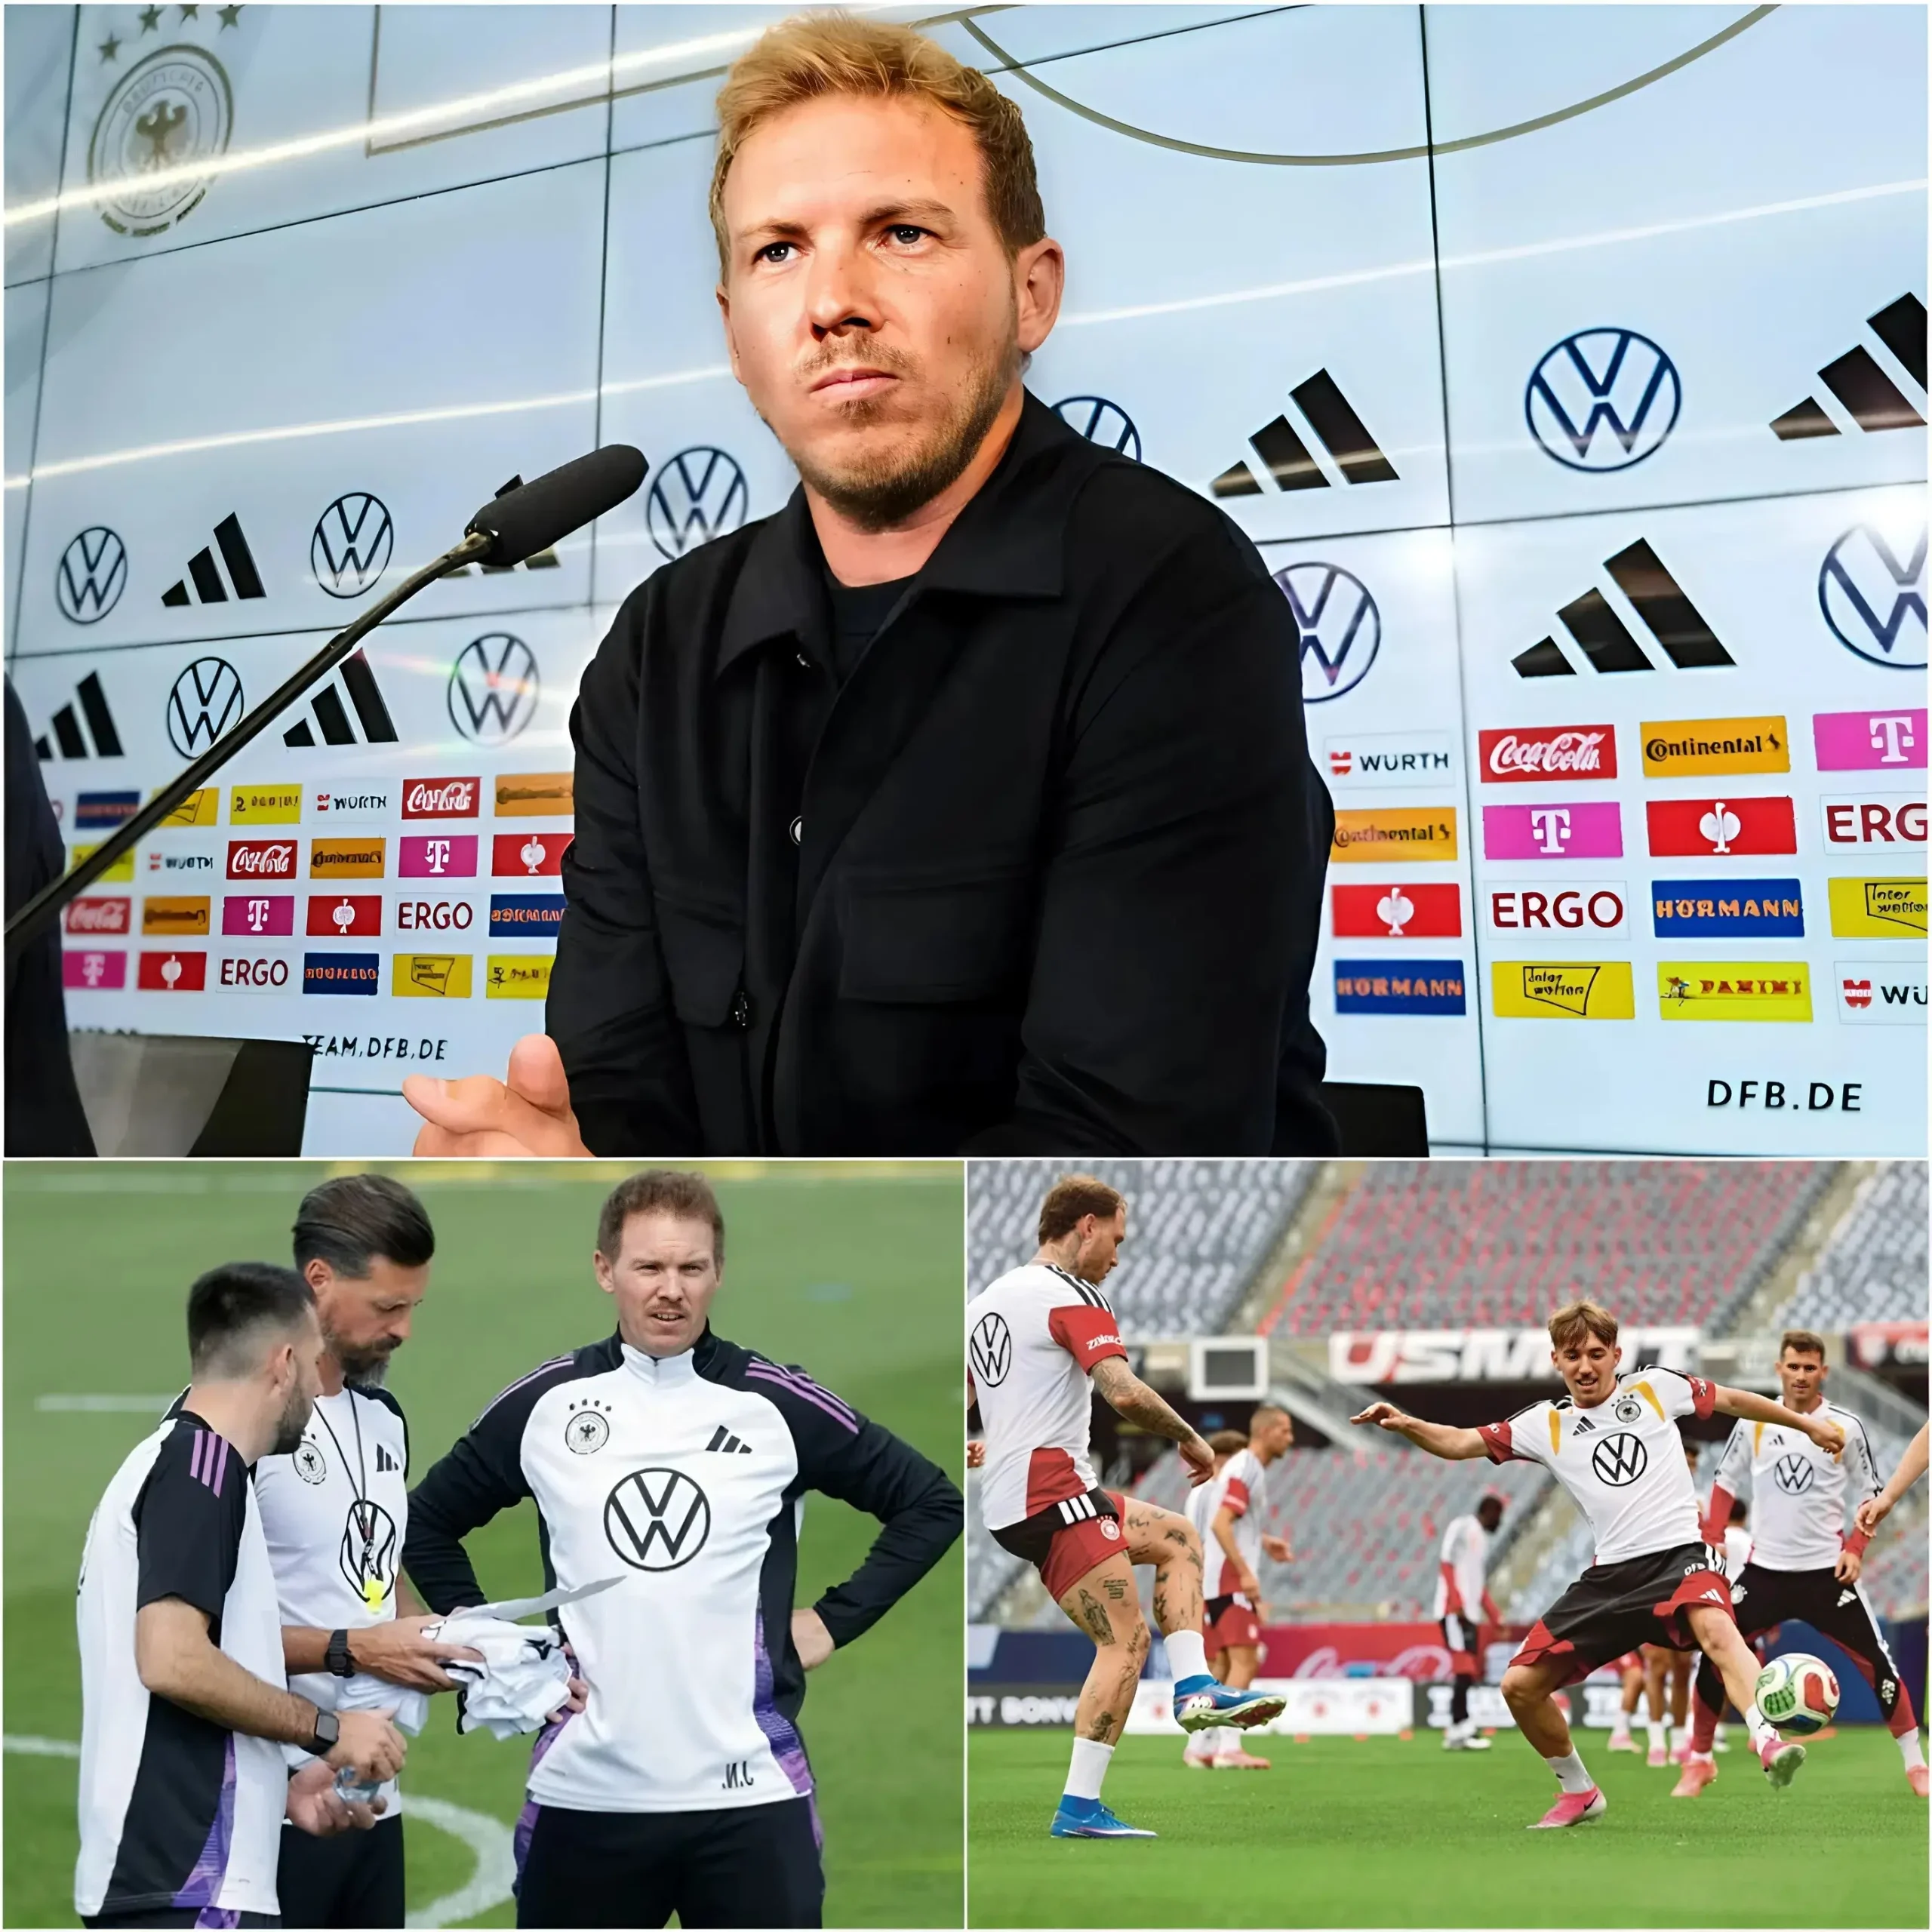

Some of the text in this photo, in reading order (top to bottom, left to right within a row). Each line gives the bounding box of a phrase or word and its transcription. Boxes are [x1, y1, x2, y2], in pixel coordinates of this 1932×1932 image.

[1646, 735, 1762, 762] Continental
[398, 902, 473, 930] ERGO
[1492, 891, 1623, 928] ERGO
[220, 958, 288, 986] ERGO
[1706, 1079, 1863, 1111] DFB.DE
